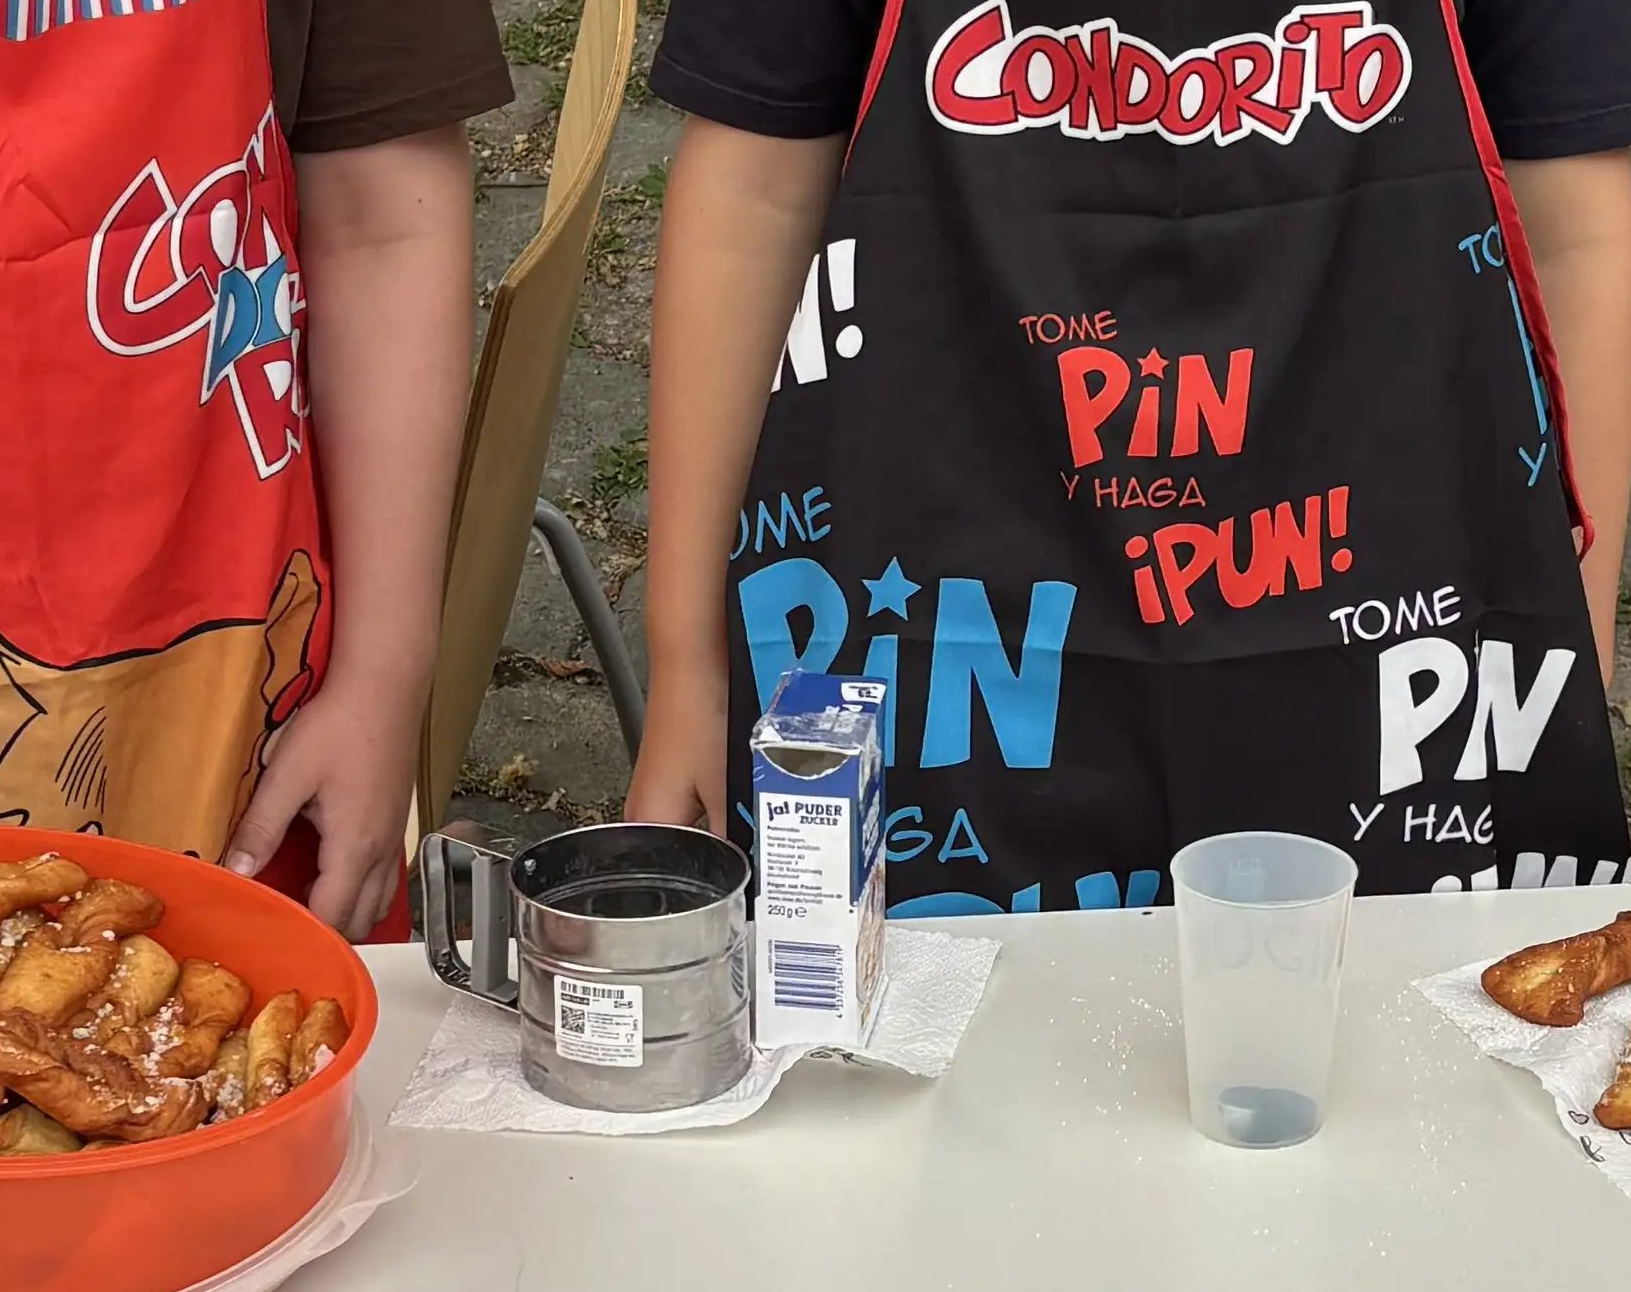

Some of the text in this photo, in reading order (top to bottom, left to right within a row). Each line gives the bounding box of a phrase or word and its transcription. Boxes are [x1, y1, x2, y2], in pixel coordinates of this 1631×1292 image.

[1019, 310, 1118, 345] TOME
[1060, 470, 1206, 509] Y HAGA
[1329, 585, 1462, 645] TOME
[766, 801, 843, 821] ja! PUDER
[799, 815, 838, 826] ZUCKER
[1349, 802, 1385, 842] Y
[767, 904, 786, 916] 250
